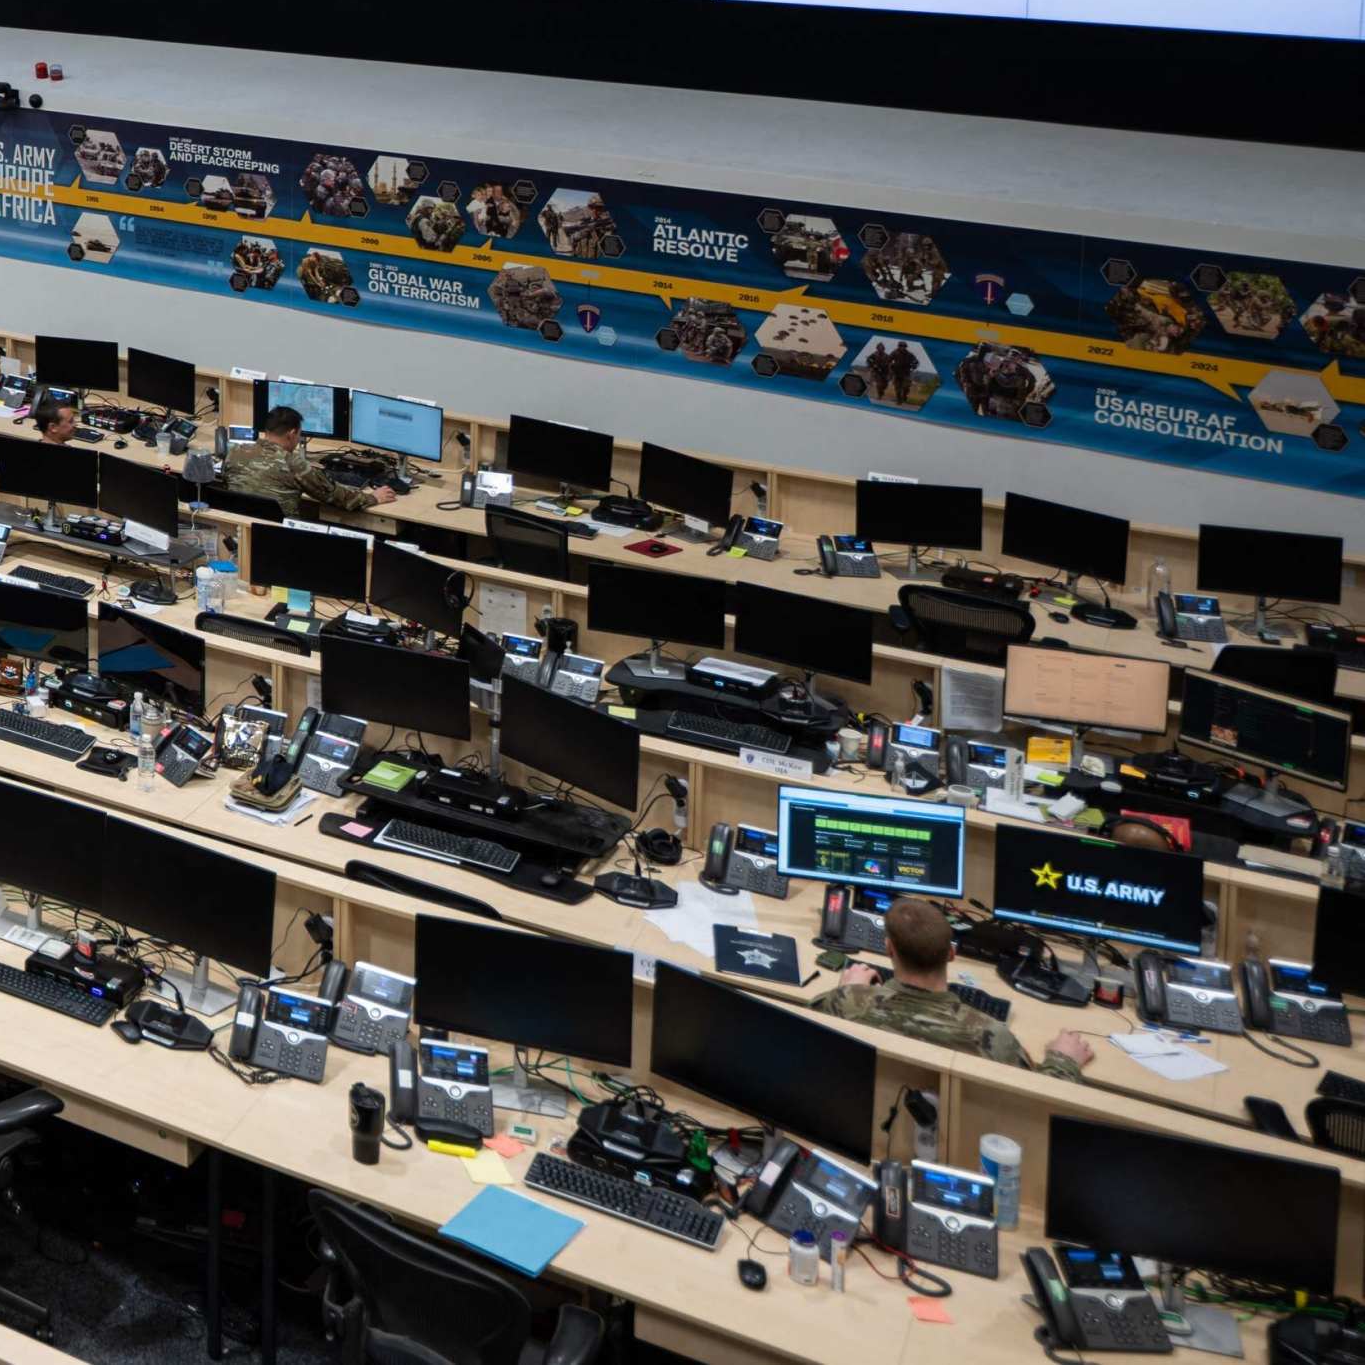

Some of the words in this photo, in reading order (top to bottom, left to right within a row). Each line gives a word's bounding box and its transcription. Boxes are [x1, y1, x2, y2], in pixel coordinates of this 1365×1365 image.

[13, 144, 56, 169] ARMY
[169, 151, 193, 163] AND
[194, 153, 280, 175] PEACEKEEPING
[170, 141, 212, 156] DESERT
[213, 146, 252, 161] STORM
[653, 223, 749, 249] ATLANTIC
[652, 237, 740, 264] RESOLVE
[368, 268, 427, 289] GLOBAL
[429, 277, 463, 294] WAR
[653, 280, 673, 290] 2014
[368, 280, 389, 294] ON
[392, 283, 480, 309] TERRORISM
[1087, 345, 1114, 357] 2022
[1190, 361, 1219, 372] 2024
[1094, 394, 1237, 430] USAREUR-AF
[1093, 409, 1284, 455] CONSOLIDATION
[1066, 873, 1103, 896] U.S.
[1104, 882, 1166, 906] ARMY
